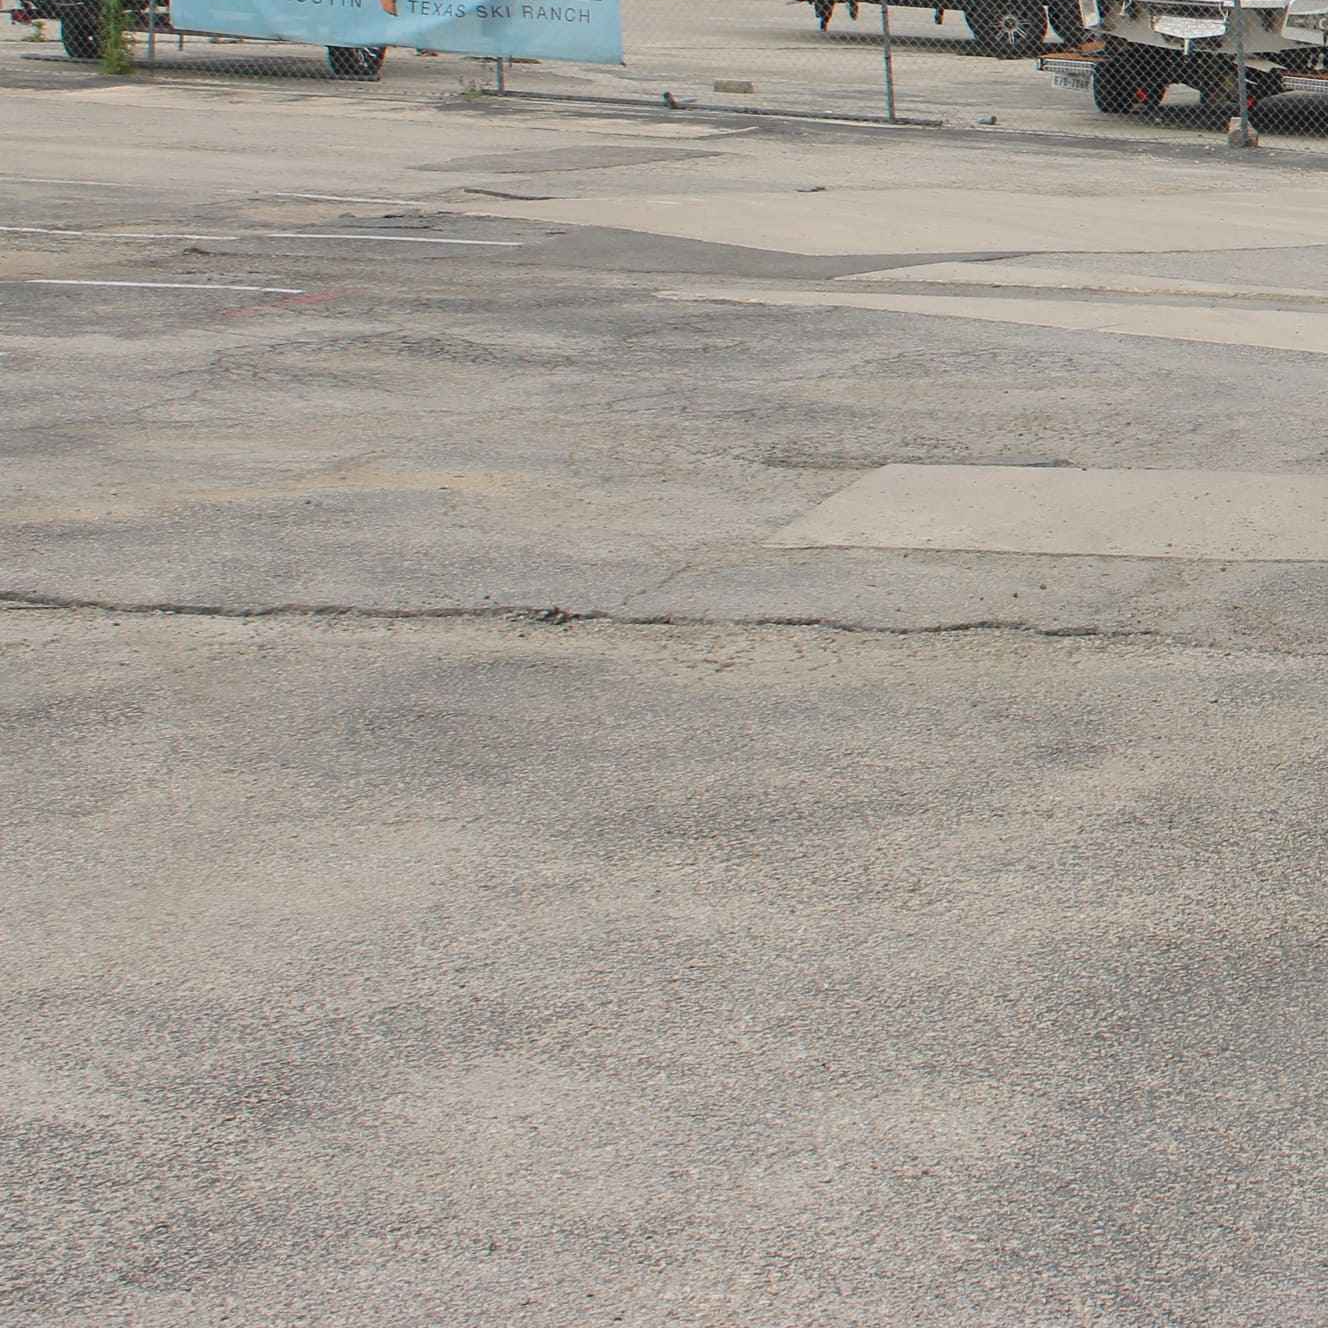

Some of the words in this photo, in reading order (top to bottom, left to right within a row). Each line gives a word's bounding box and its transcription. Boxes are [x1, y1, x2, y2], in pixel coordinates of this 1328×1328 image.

[408, 0, 467, 19] TEXAS
[476, 6, 512, 19] SKI
[523, 5, 592, 24] RANCH
